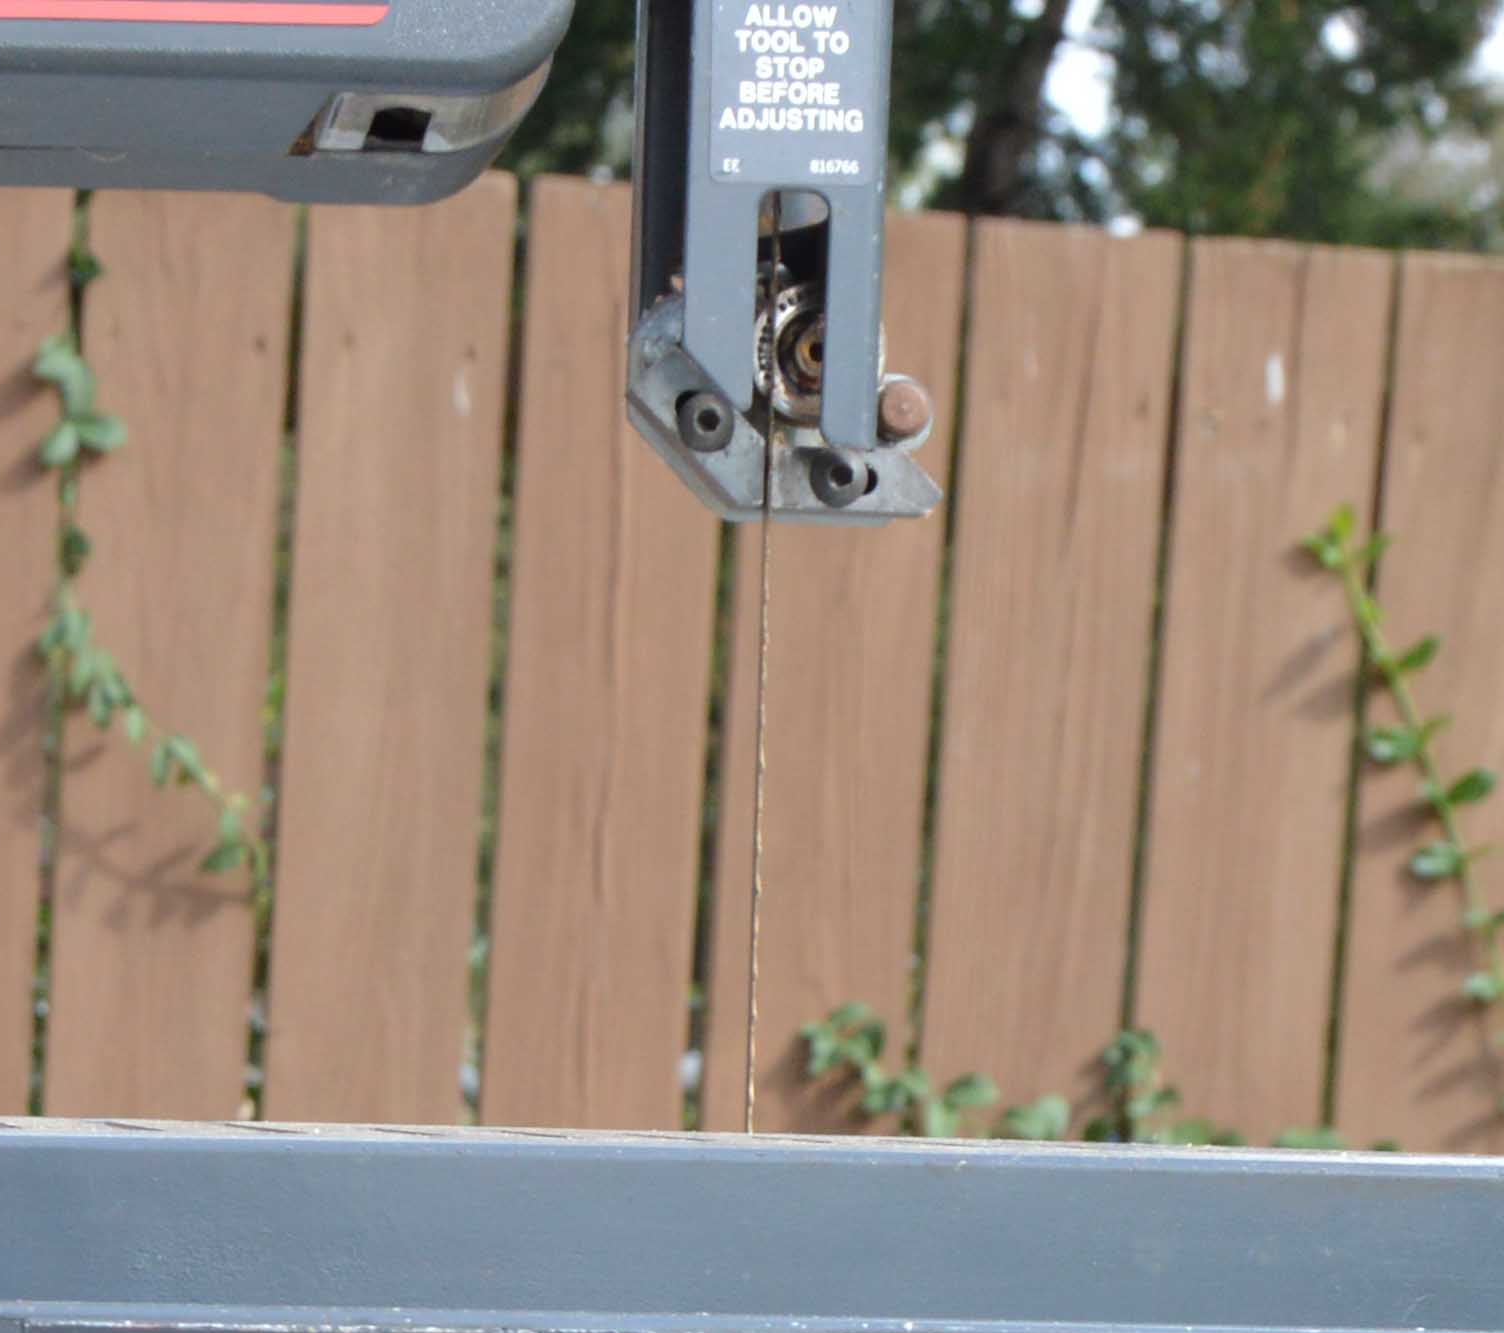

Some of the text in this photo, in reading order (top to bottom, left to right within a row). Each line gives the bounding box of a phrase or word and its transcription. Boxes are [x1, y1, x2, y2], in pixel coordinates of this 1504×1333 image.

[744, 4, 838, 29] ALLOW
[734, 29, 850, 55] TOOL TO
[755, 56, 825, 80] STOP
[739, 80, 840, 106] BEFORE
[718, 106, 864, 133] ADJUSTING
